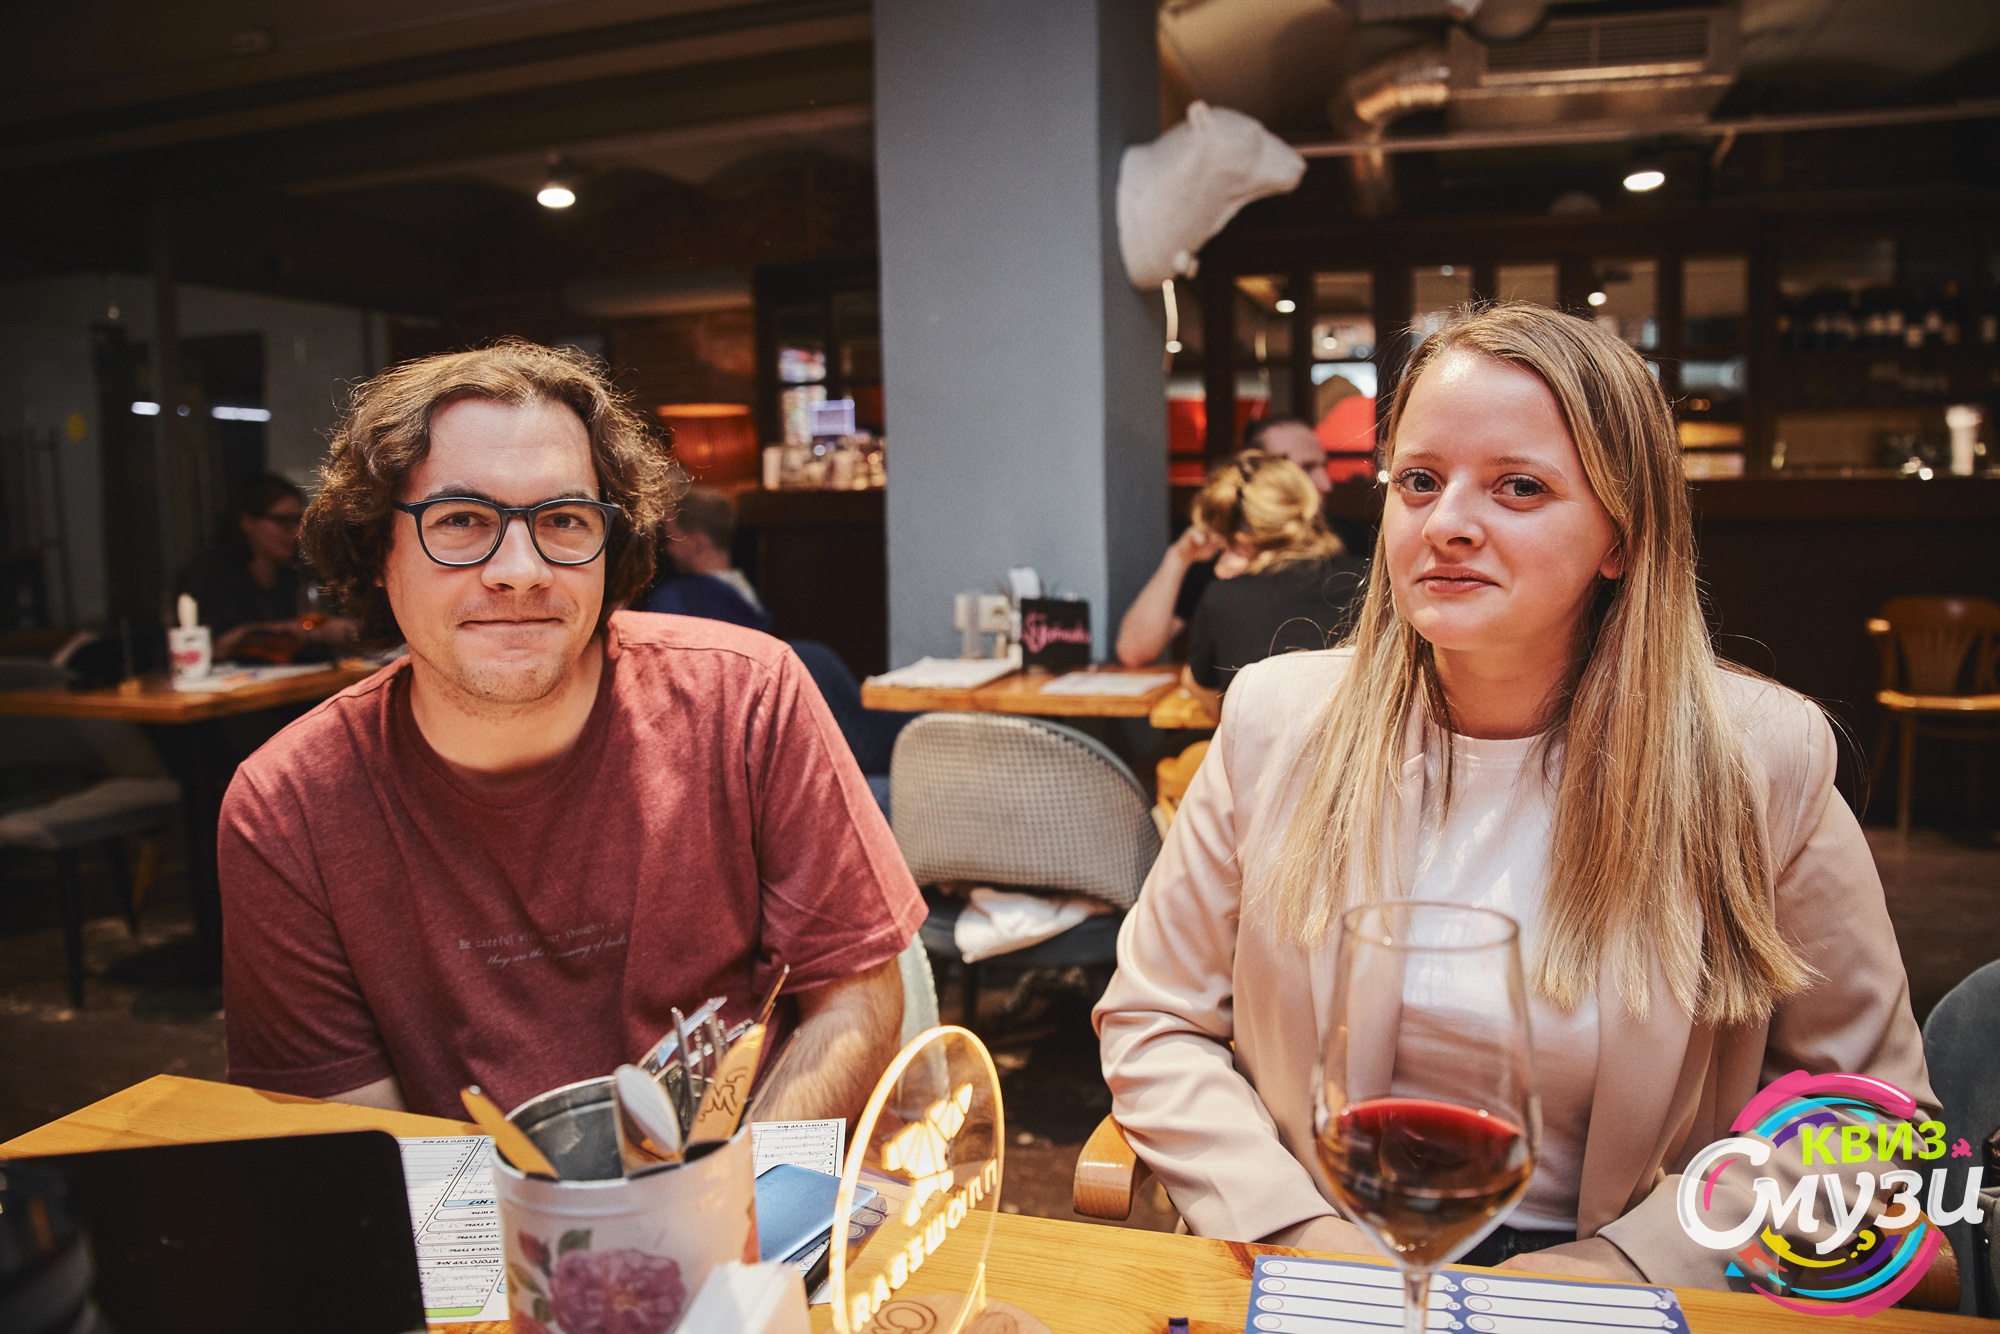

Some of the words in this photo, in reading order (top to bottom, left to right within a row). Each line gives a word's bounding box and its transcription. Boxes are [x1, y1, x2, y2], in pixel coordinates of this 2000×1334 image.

[458, 938, 471, 950] Be
[475, 933, 515, 949] careful
[486, 952, 511, 970] they
